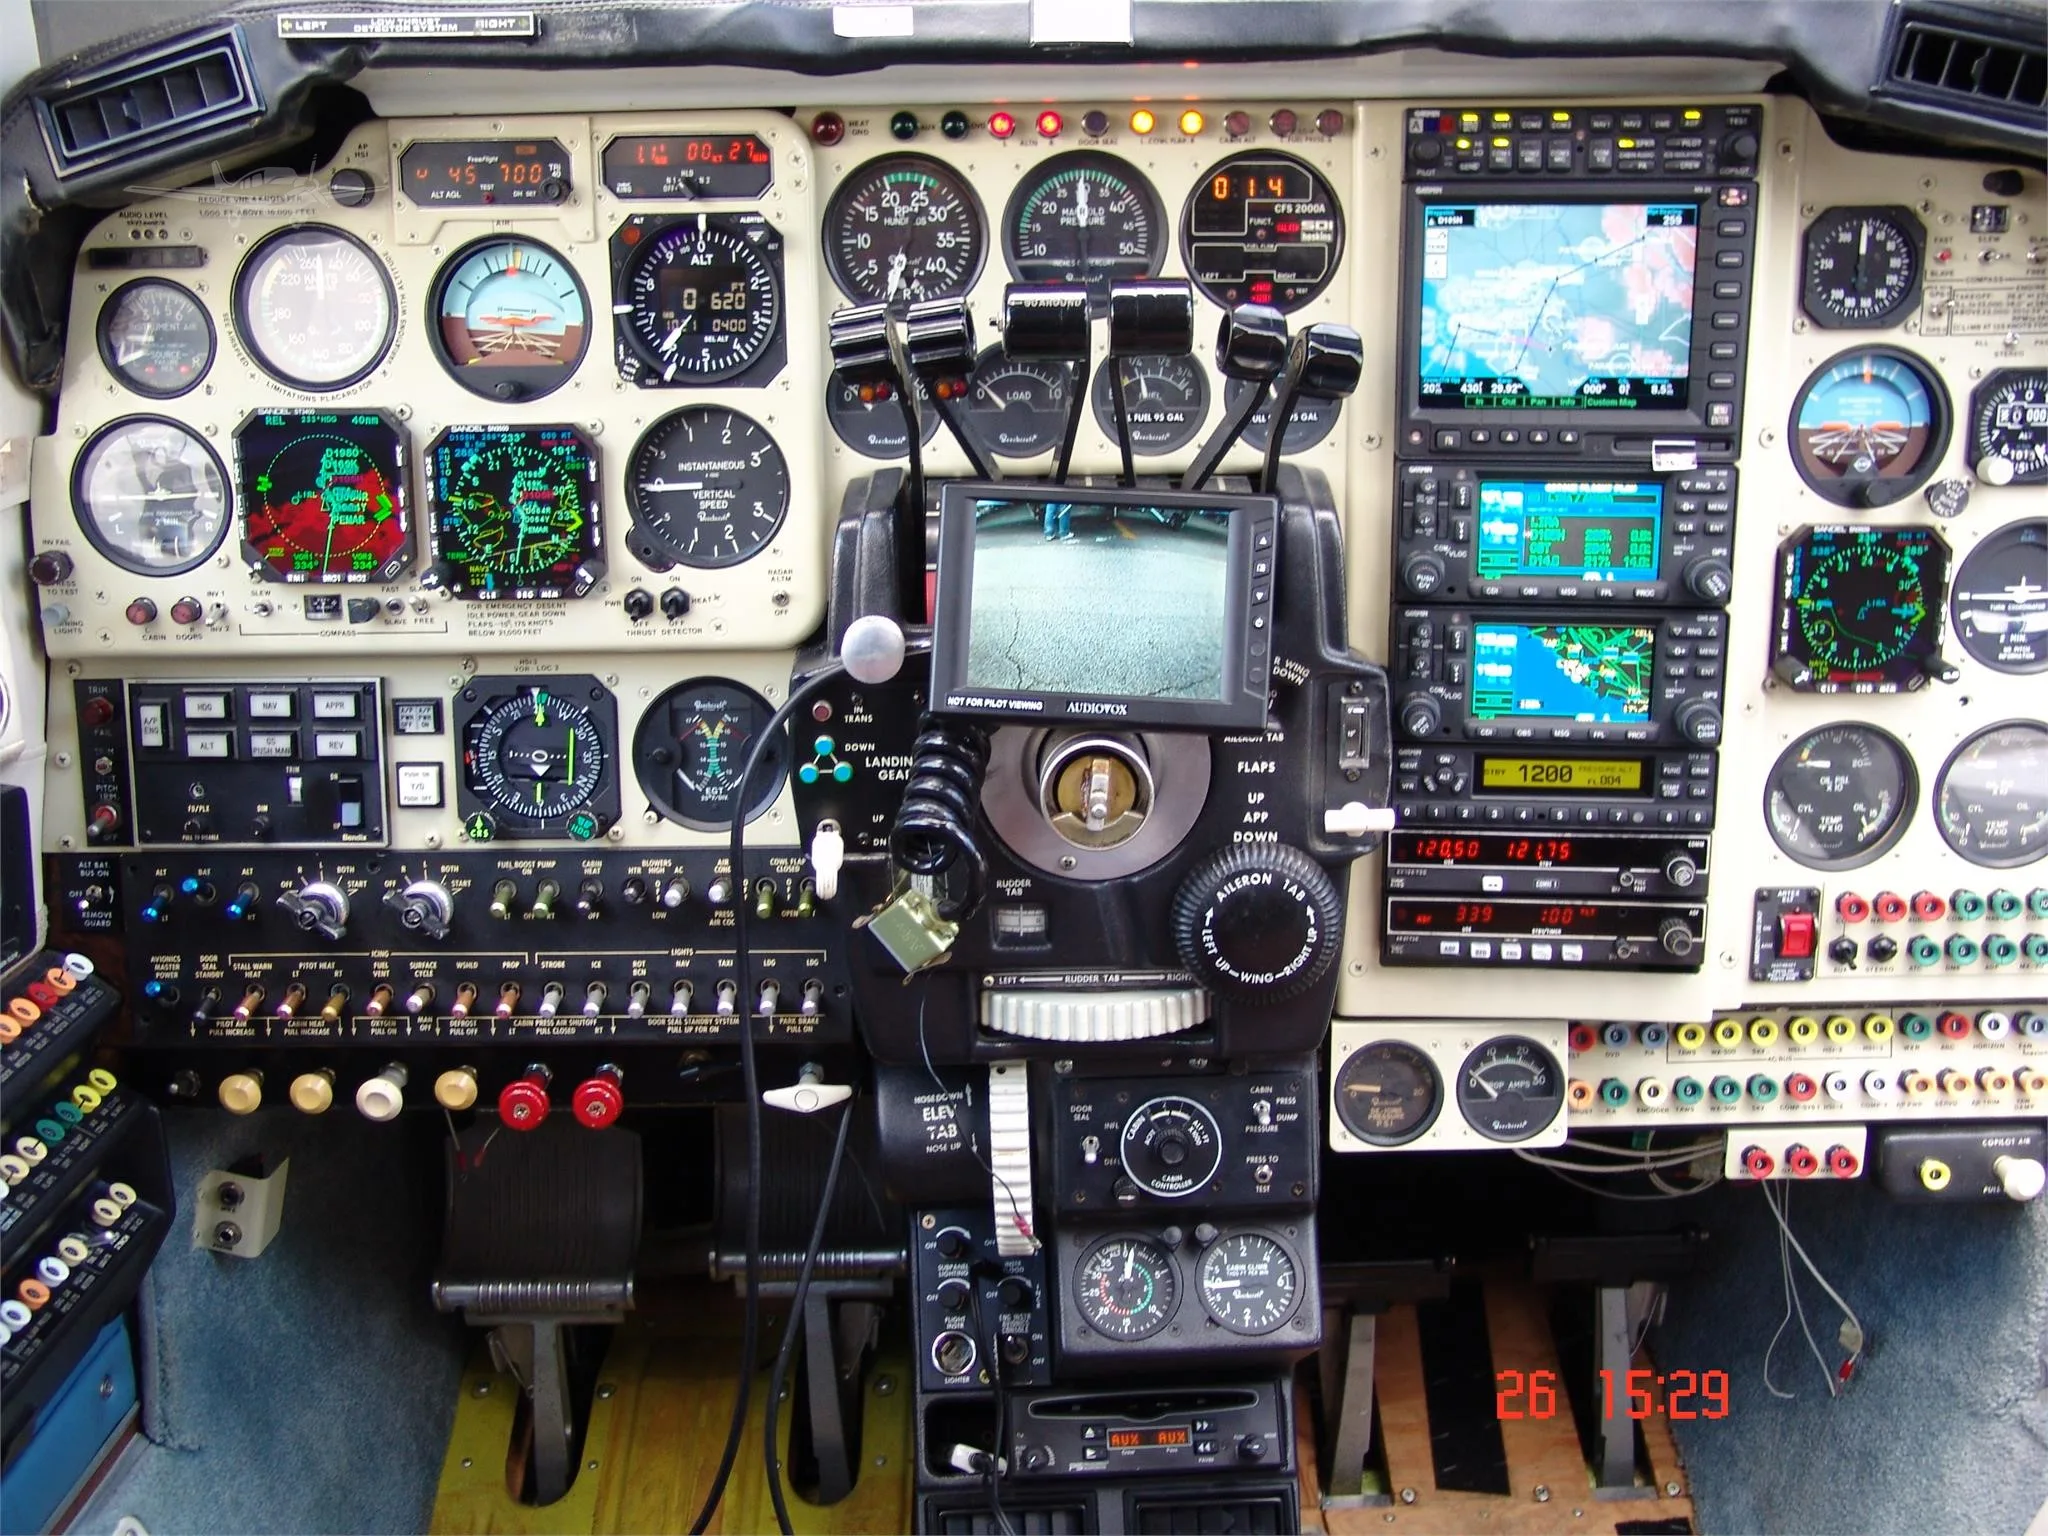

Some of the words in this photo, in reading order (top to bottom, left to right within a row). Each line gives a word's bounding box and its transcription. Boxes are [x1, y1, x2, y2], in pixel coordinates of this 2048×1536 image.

[296, 21, 327, 31] LEFT
[354, 25, 410, 33] DETECTOR
[413, 24, 458, 32] SYSTEM
[475, 19, 515, 29] RIGHT
[882, 192, 899, 206] 20
[911, 192, 928, 206] 25
[1275, 203, 1292, 213] CFS
[1295, 203, 1325, 213] 2000A
[865, 207, 878, 222] 15
[928, 207, 947, 222] 30
[857, 234, 870, 248] 10
[936, 233, 955, 247] 35
[691, 254, 713, 265] ALT
[926, 257, 946, 271] 40
[731, 283, 745, 292] FT
[683, 289, 696, 310] 0
[711, 293, 746, 310] 620
[712, 319, 746, 332] 0400
[266, 381, 317, 402] LIMITATIONS
[320, 387, 354, 402] PLACARD
[1006, 391, 1032, 400] LOAD
[1531, 398, 1546, 406] Pan
[1560, 398, 1575, 406] Info
[1588, 398, 1615, 407] Custom
[1618, 398, 1637, 408] Map
[265, 416, 285, 426] REL
[351, 416, 379, 426] 40nm
[722, 430, 731, 444] 2
[751, 453, 760, 466] 3
[678, 460, 745, 472] INSTANTANEOUS
[693, 491, 735, 499] VERTICAL
[700, 501, 728, 509] SPEED
[333, 515, 365, 524] PEMAR
[197, 703, 212, 711] HDG
[262, 702, 277, 710] NAV
[325, 702, 345, 710] APPR
[948, 696, 964, 706] NOT
[966, 697, 982, 706] FOR
[984, 698, 1008, 709] PILOT
[1009, 700, 1043, 711] VIEWING
[1067, 701, 1128, 715] AUDIOVOX
[844, 715, 873, 723] TRANS
[200, 742, 214, 750] ALT
[329, 741, 343, 749] REV
[844, 743, 875, 752] DOWN
[865, 756, 913, 768] LANDIN
[1237, 761, 1276, 774] FLAPS
[1518, 764, 1573, 783] 1200
[705, 787, 724, 797] EGT
[1248, 792, 1264, 804] UP
[1798, 804, 1813, 813] CYL
[872, 815, 884, 823] UP
[1243, 812, 1268, 823] APP
[1821, 816, 1843, 824] TEMP
[1233, 831, 1278, 843] DOWN
[497, 861, 512, 869] FUEL
[513, 861, 535, 869] BOOST
[641, 859, 672, 867] BLOWERS
[80, 869, 96, 877] BUS
[98, 869, 109, 877] ON
[337, 865, 355, 874] BOTH
[996, 879, 1031, 888] RUDDER
[1216, 872, 1272, 902] AILERON
[1282, 879, 1305, 902] TAB
[1005, 888, 1023, 896] TAB
[1456, 907, 1493, 923] 339
[671, 948, 694, 956] LIGHTS
[1202, 929, 1218, 955] LEFT
[1215, 955, 1230, 973] UP
[1240, 971, 1274, 985] WING
[1283, 945, 1313, 975] RIGHT
[1305, 928, 1317, 943] UP
[150, 955, 181, 963] AVIONICS
[154, 963, 181, 971] MASTER
[502, 961, 520, 969] PROP
[541, 961, 566, 969] STROBE
[155, 971, 179, 979] POWER
[195, 970, 224, 978] STANDBY
[415, 970, 434, 978] CYCLE
[999, 975, 1017, 984] LEFT
[1064, 974, 1099, 983] RUDDER
[1104, 974, 1120, 982] TAB
[513, 1019, 533, 1027] CABIN
[535, 1019, 553, 1027] PRESS
[555, 1018, 566, 1026] AIR
[568, 1017, 597, 1026] SHUTOFF
[1486, 1047, 1496, 1056] 10
[1517, 1046, 1529, 1055] 20
[1508, 1080, 1531, 1089] AMPS
[1250, 1086, 1273, 1094] CABIN
[1276, 1097, 1297, 1105] PRESS
[922, 1105, 955, 1121] ELEV
[1071, 1105, 1092, 1113] DOOR
[1073, 1113, 1090, 1121] SEAL
[1276, 1113, 1298, 1121] DUMP
[926, 1124, 958, 1138] TAB
[1245, 1125, 1279, 1133] PRESSURE
[1982, 1138, 2016, 1148] COPILOT
[2018, 1137, 2031, 1146] AIR
[950, 1143, 961, 1152] UP
[1246, 1156, 1266, 1164] PRESS
[1268, 1155, 1279, 1163] TO
[1162, 1174, 1183, 1182] CABIN
[1151, 1178, 1193, 1191] CONTROLLER
[1255, 1185, 1271, 1193] TEST
